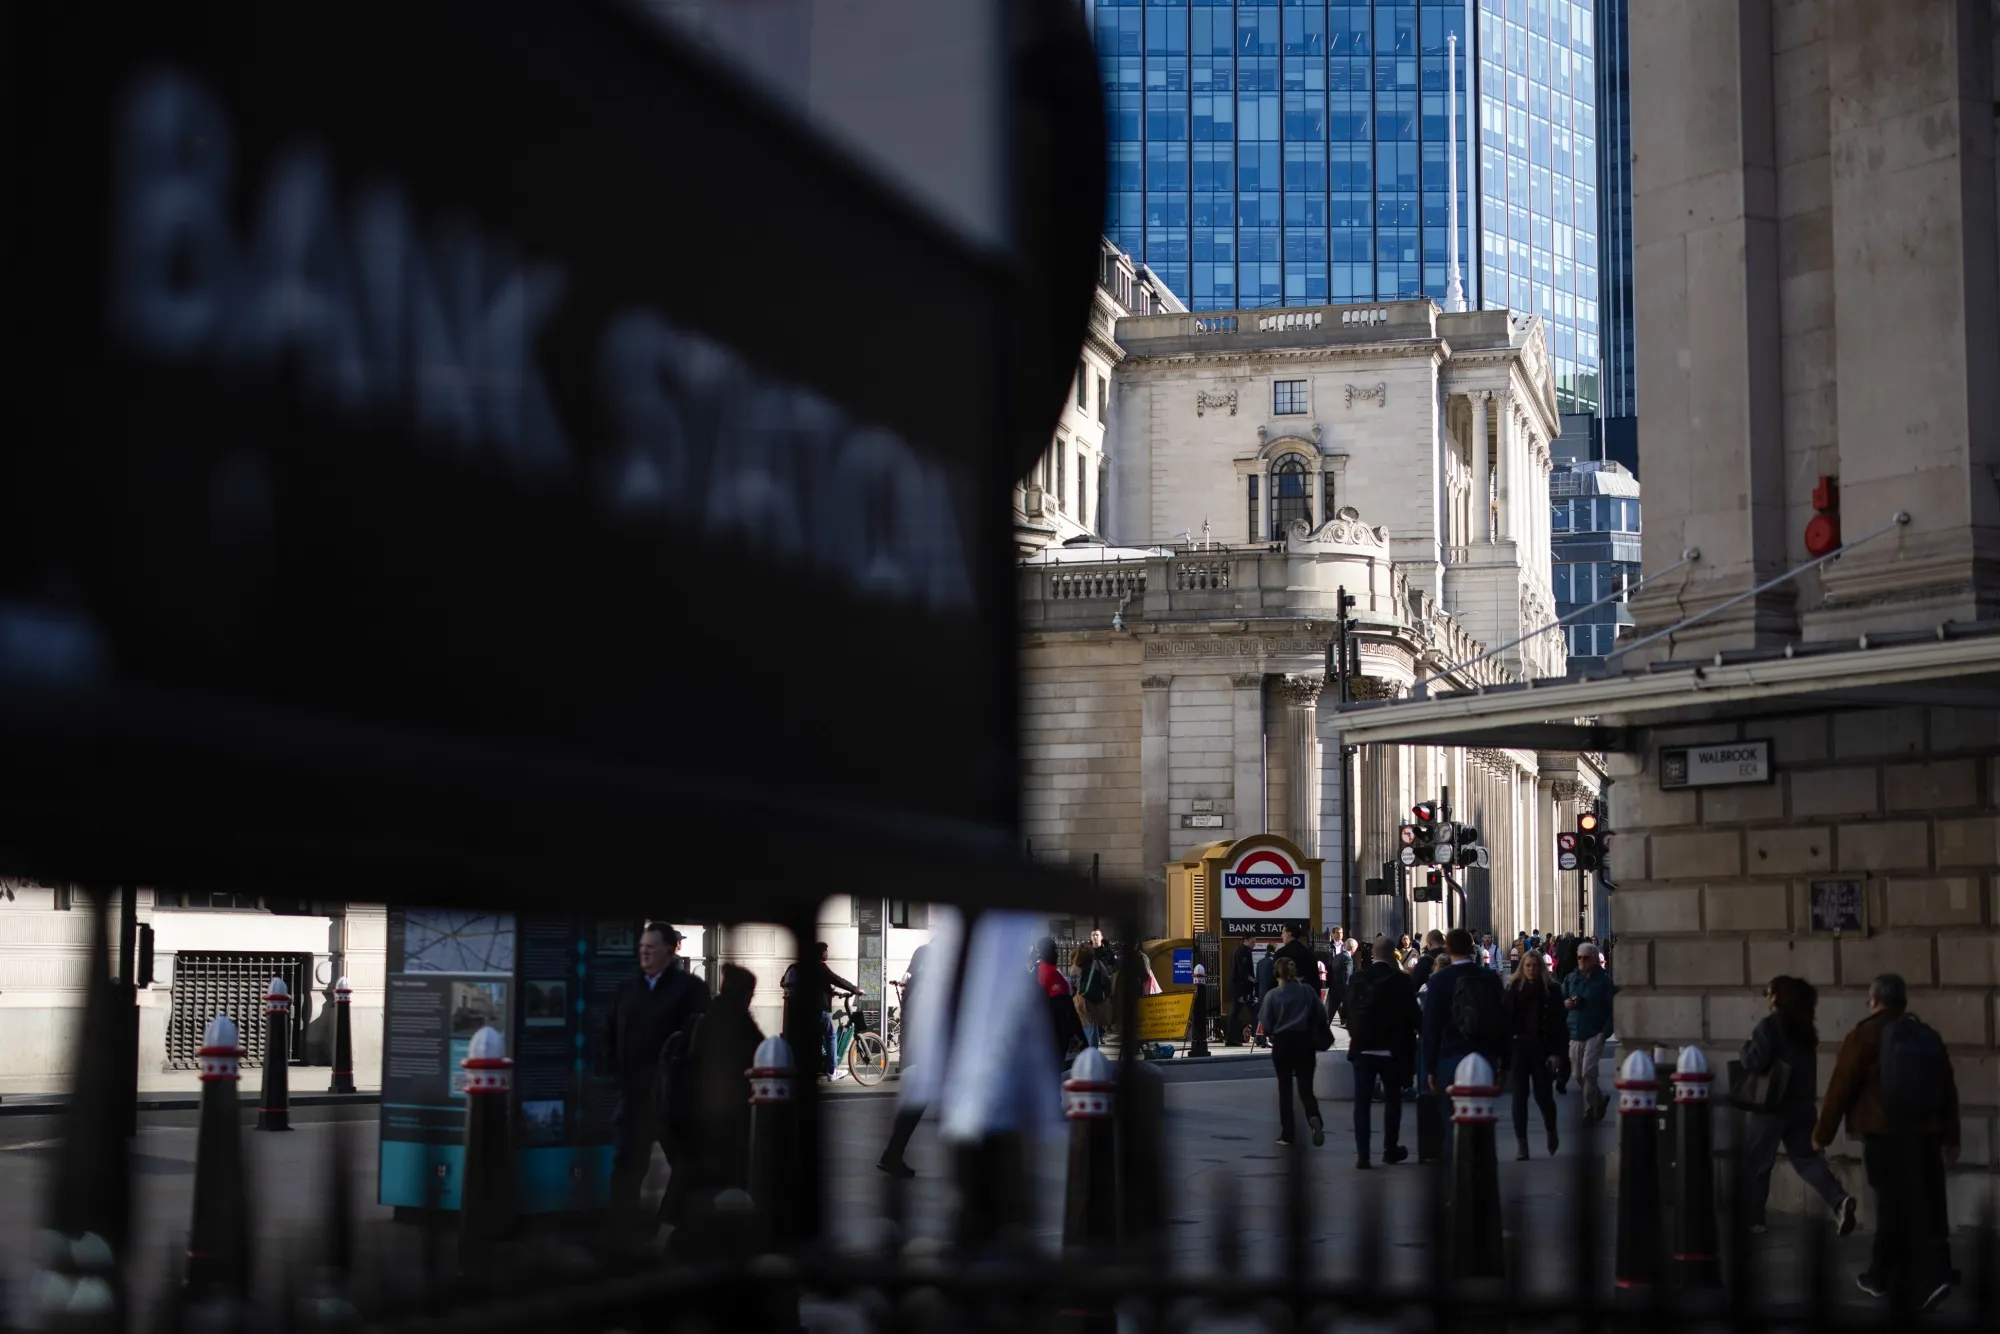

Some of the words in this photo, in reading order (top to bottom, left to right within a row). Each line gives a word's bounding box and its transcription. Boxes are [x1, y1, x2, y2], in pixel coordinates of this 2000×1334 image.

[107, 55, 580, 485] BANK
[1699, 748, 1758, 764] WALBROOK
[1739, 763, 1758, 776] EC4
[1228, 876, 1302, 887] UNDERGROUND
[1229, 923, 1256, 933] BANK
